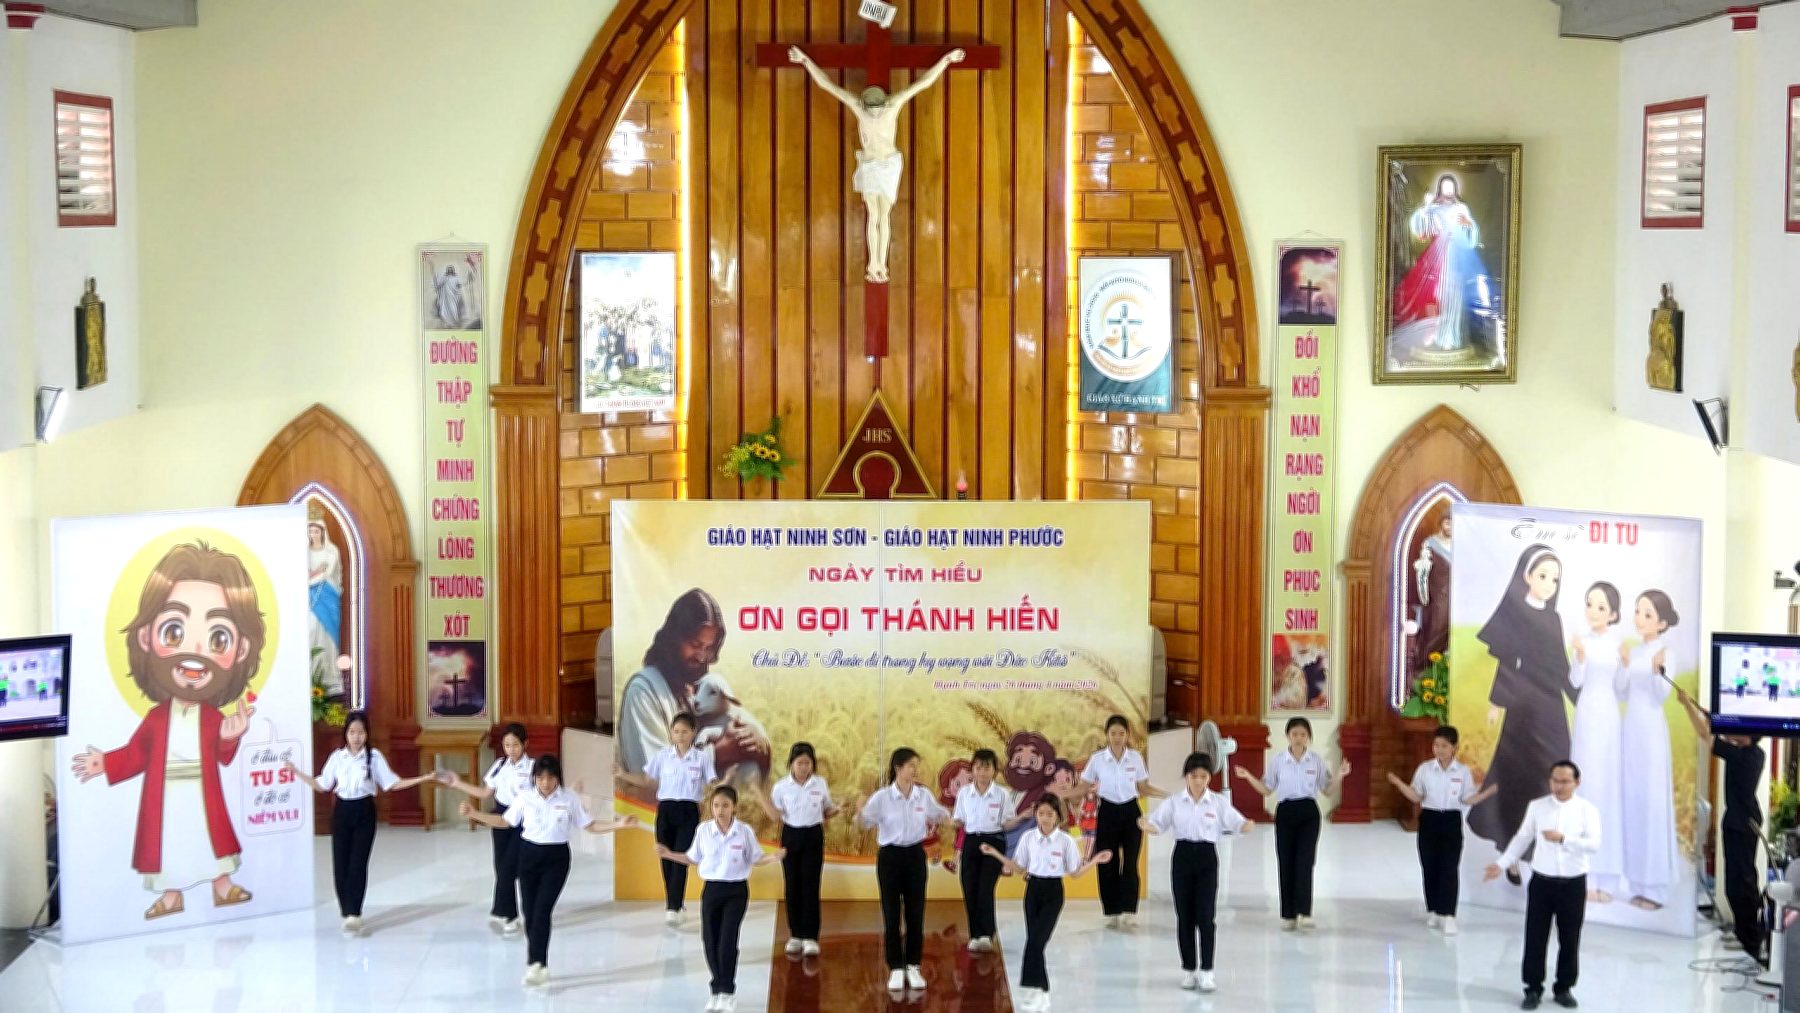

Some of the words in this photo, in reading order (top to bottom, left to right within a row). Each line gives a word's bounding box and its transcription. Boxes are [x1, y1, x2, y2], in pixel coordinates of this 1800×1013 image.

[429, 336, 478, 364] ĐƯỜNG
[436, 376, 472, 408] THẬP
[446, 418, 466, 448] TỰ
[1290, 414, 1321, 442] NẠN
[436, 459, 475, 482] MINH
[1285, 453, 1323, 480] RẠNG
[432, 493, 480, 521] CHỨNG
[1287, 487, 1320, 515] NGỜI
[438, 531, 474, 560] LÒNG
[708, 524, 746, 546] GIÁO
[751, 528, 782, 550] HẠT
[787, 528, 828, 546] NINH
[832, 527, 867, 546] SƠN
[884, 525, 923, 546] GIÁO
[927, 528, 958, 550] HẠT
[963, 528, 1003, 546] NINH
[1008, 525, 1064, 546] PHƯỚC
[1293, 529, 1313, 553] ƠN
[1589, 520, 1608, 544] ĐI
[1615, 522, 1639, 545] TU
[809, 562, 874, 582] NGÀY
[885, 563, 923, 582] TÌM
[931, 560, 982, 582] HIỂU
[1283, 569, 1321, 597] PHỤC
[430, 573, 484, 598] THƯƠNG
[444, 610, 470, 638] XÓT
[738, 605, 783, 631] ƠN
[797, 607, 849, 637] GỌI
[861, 599, 974, 631] THÁNH
[987, 593, 1059, 631] HIẾN
[1284, 608, 1318, 631] SINH
[250, 770, 273, 787] TU
